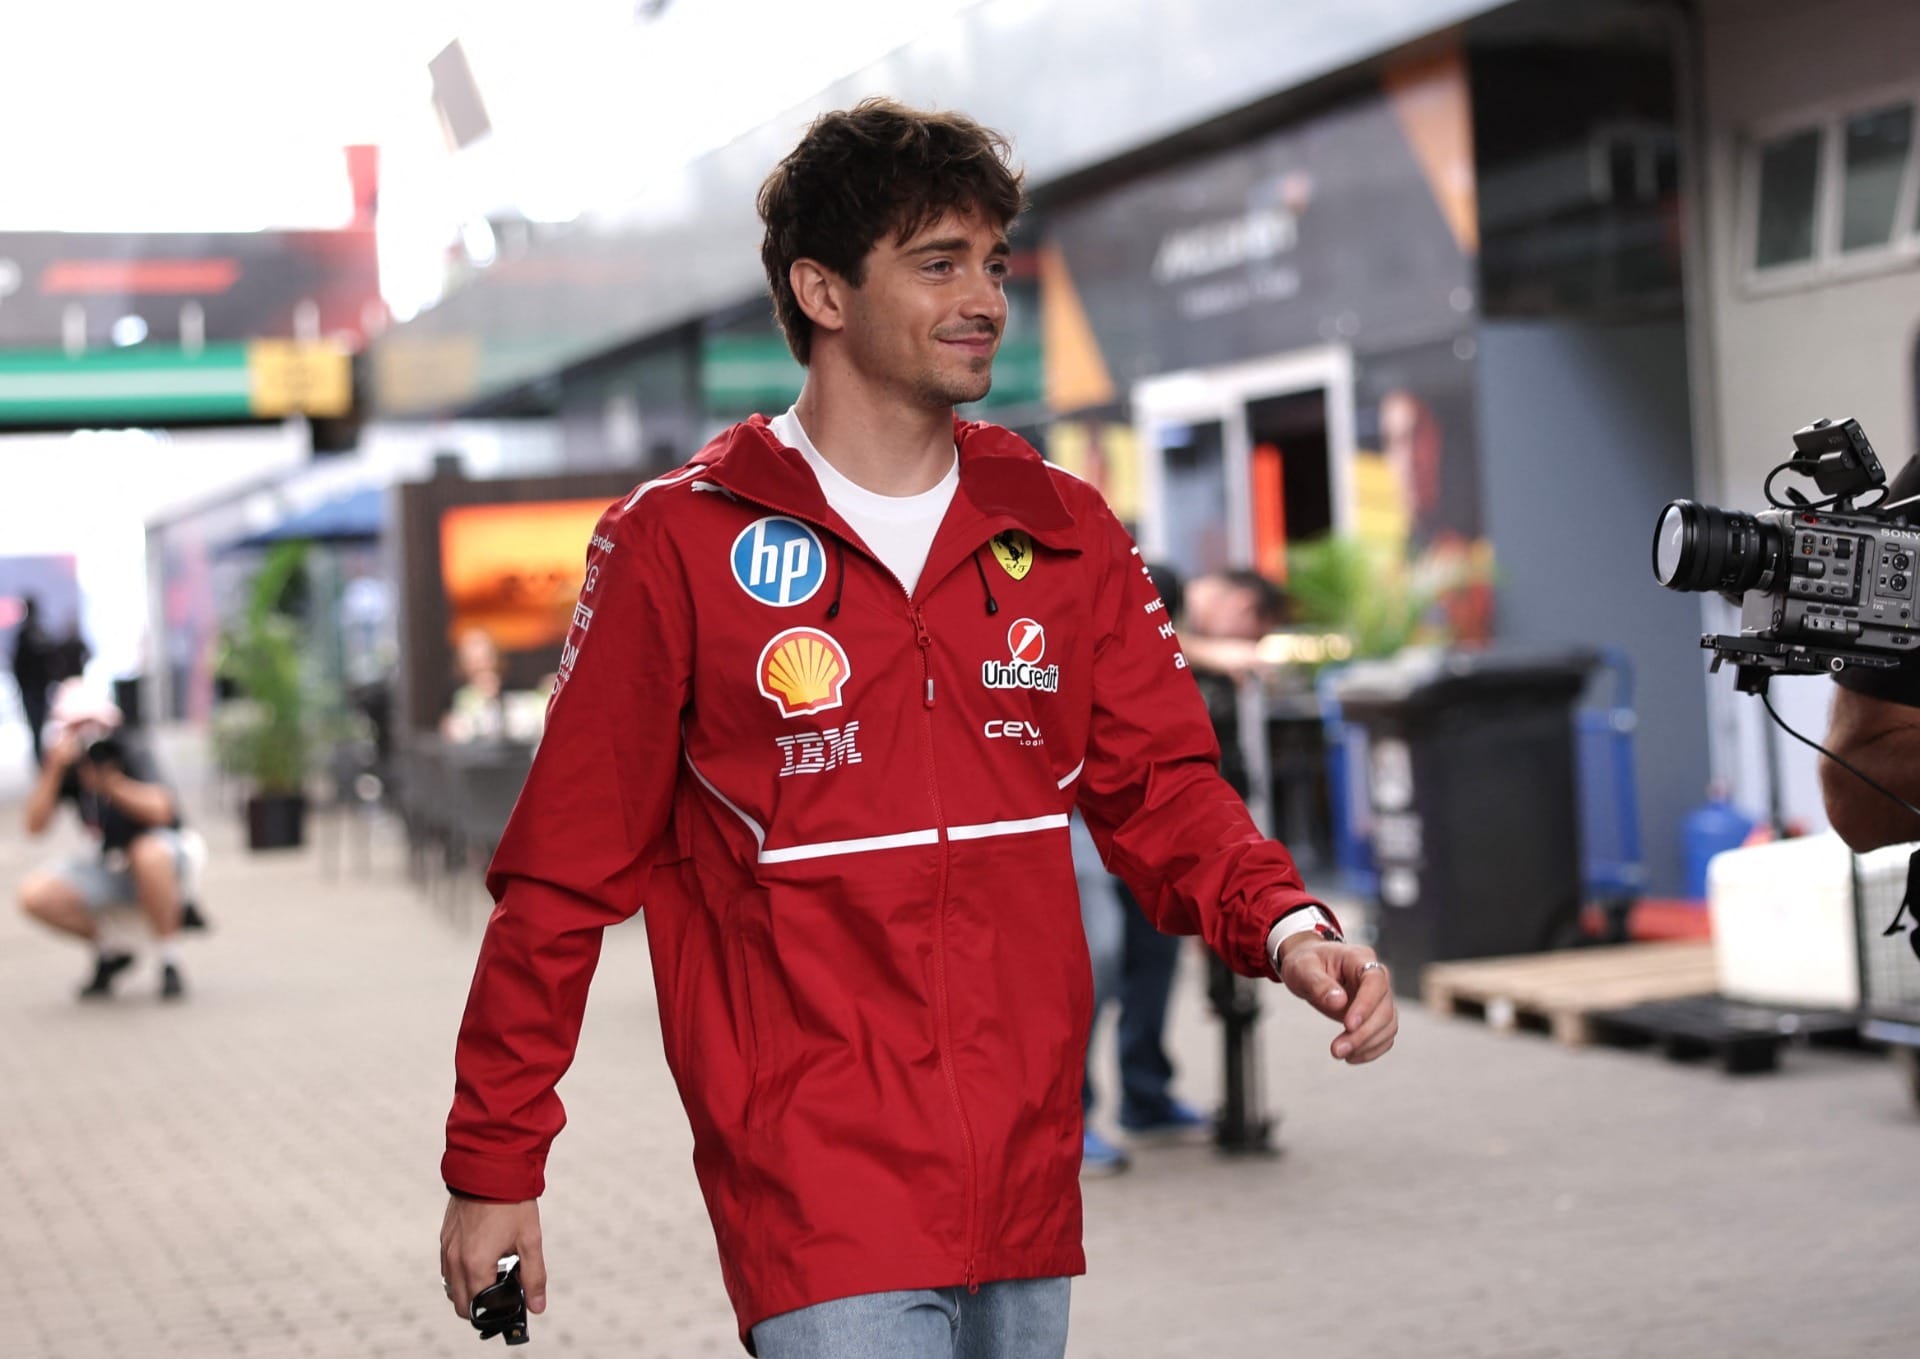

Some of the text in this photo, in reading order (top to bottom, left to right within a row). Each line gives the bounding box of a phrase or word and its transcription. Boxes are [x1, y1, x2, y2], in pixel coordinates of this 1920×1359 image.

[591, 533, 616, 554] ender
[1881, 528, 1920, 540] SONY
[750, 519, 810, 603] hp
[983, 661, 1058, 692] UniCredit
[775, 720, 862, 777] IBM
